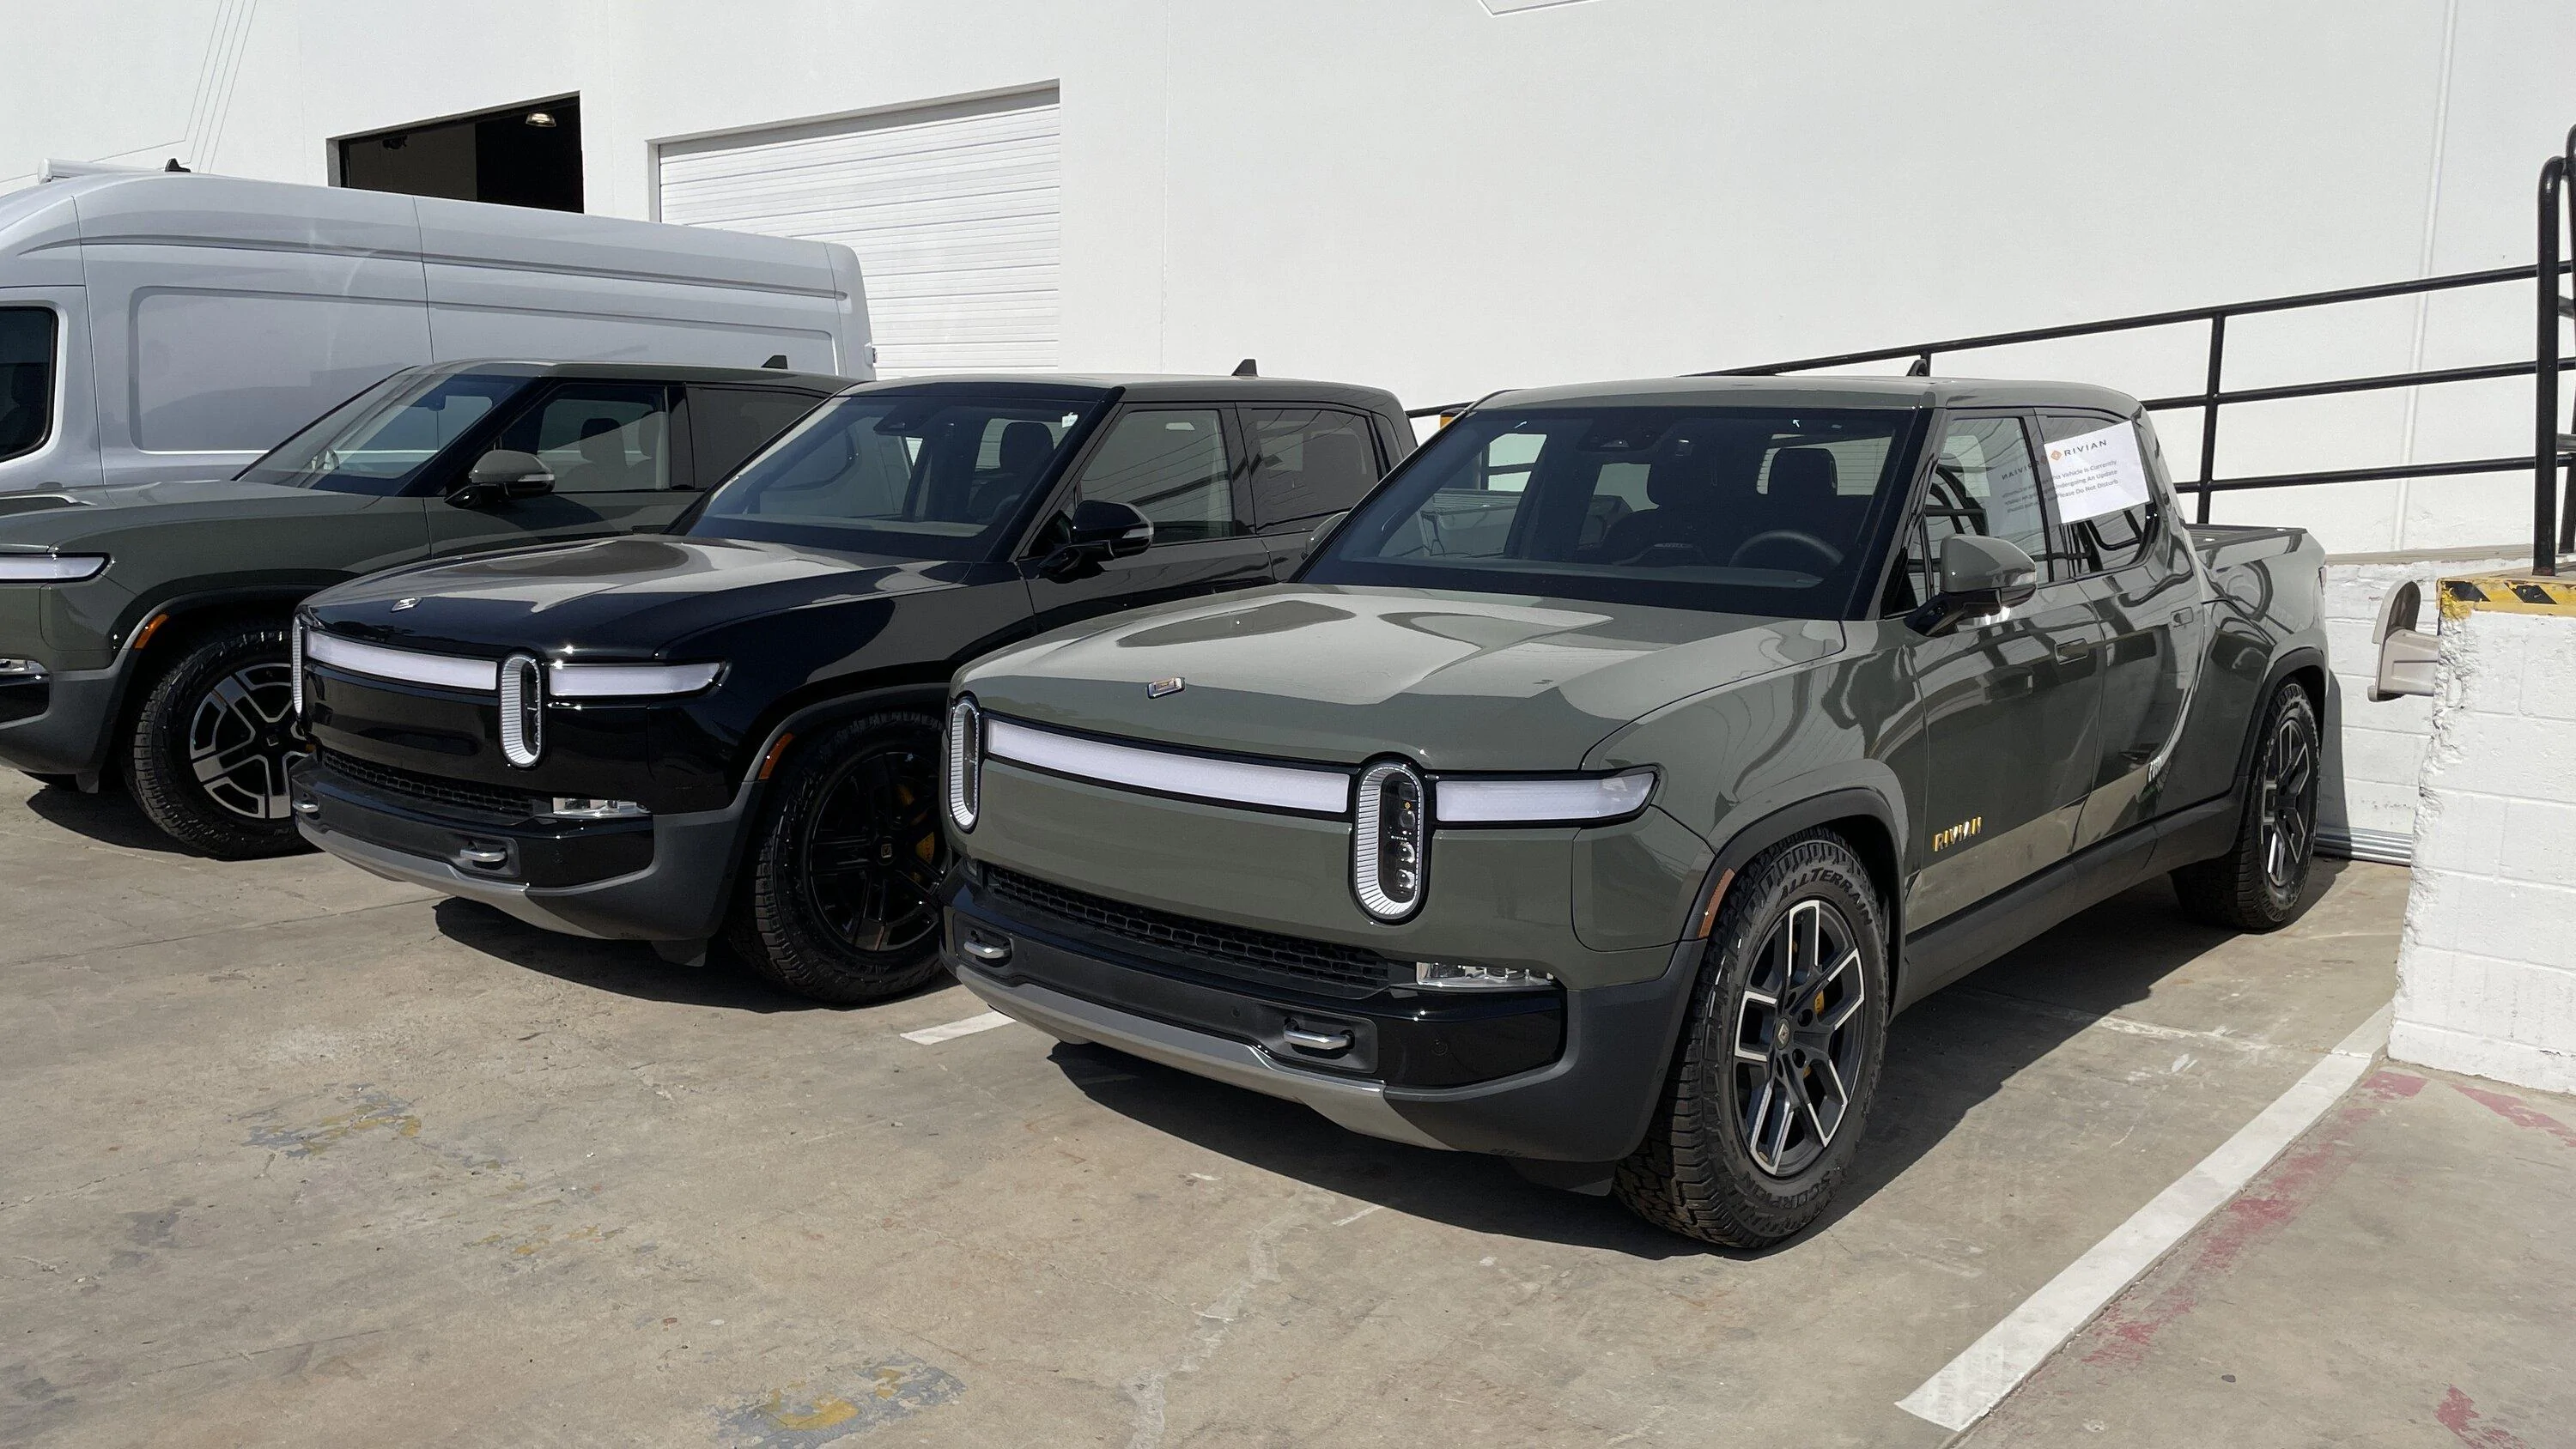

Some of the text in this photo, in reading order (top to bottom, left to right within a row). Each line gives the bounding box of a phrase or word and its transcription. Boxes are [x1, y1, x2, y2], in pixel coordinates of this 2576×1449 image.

[2063, 440, 2107, 456] RIVIAN
[2061, 469, 2083, 478] Vehicle
[2089, 459, 2117, 470] Currently
[2096, 470, 2117, 479] Update
[2097, 479, 2119, 488] Disturb
[1933, 816, 1982, 852] RIVIAN
